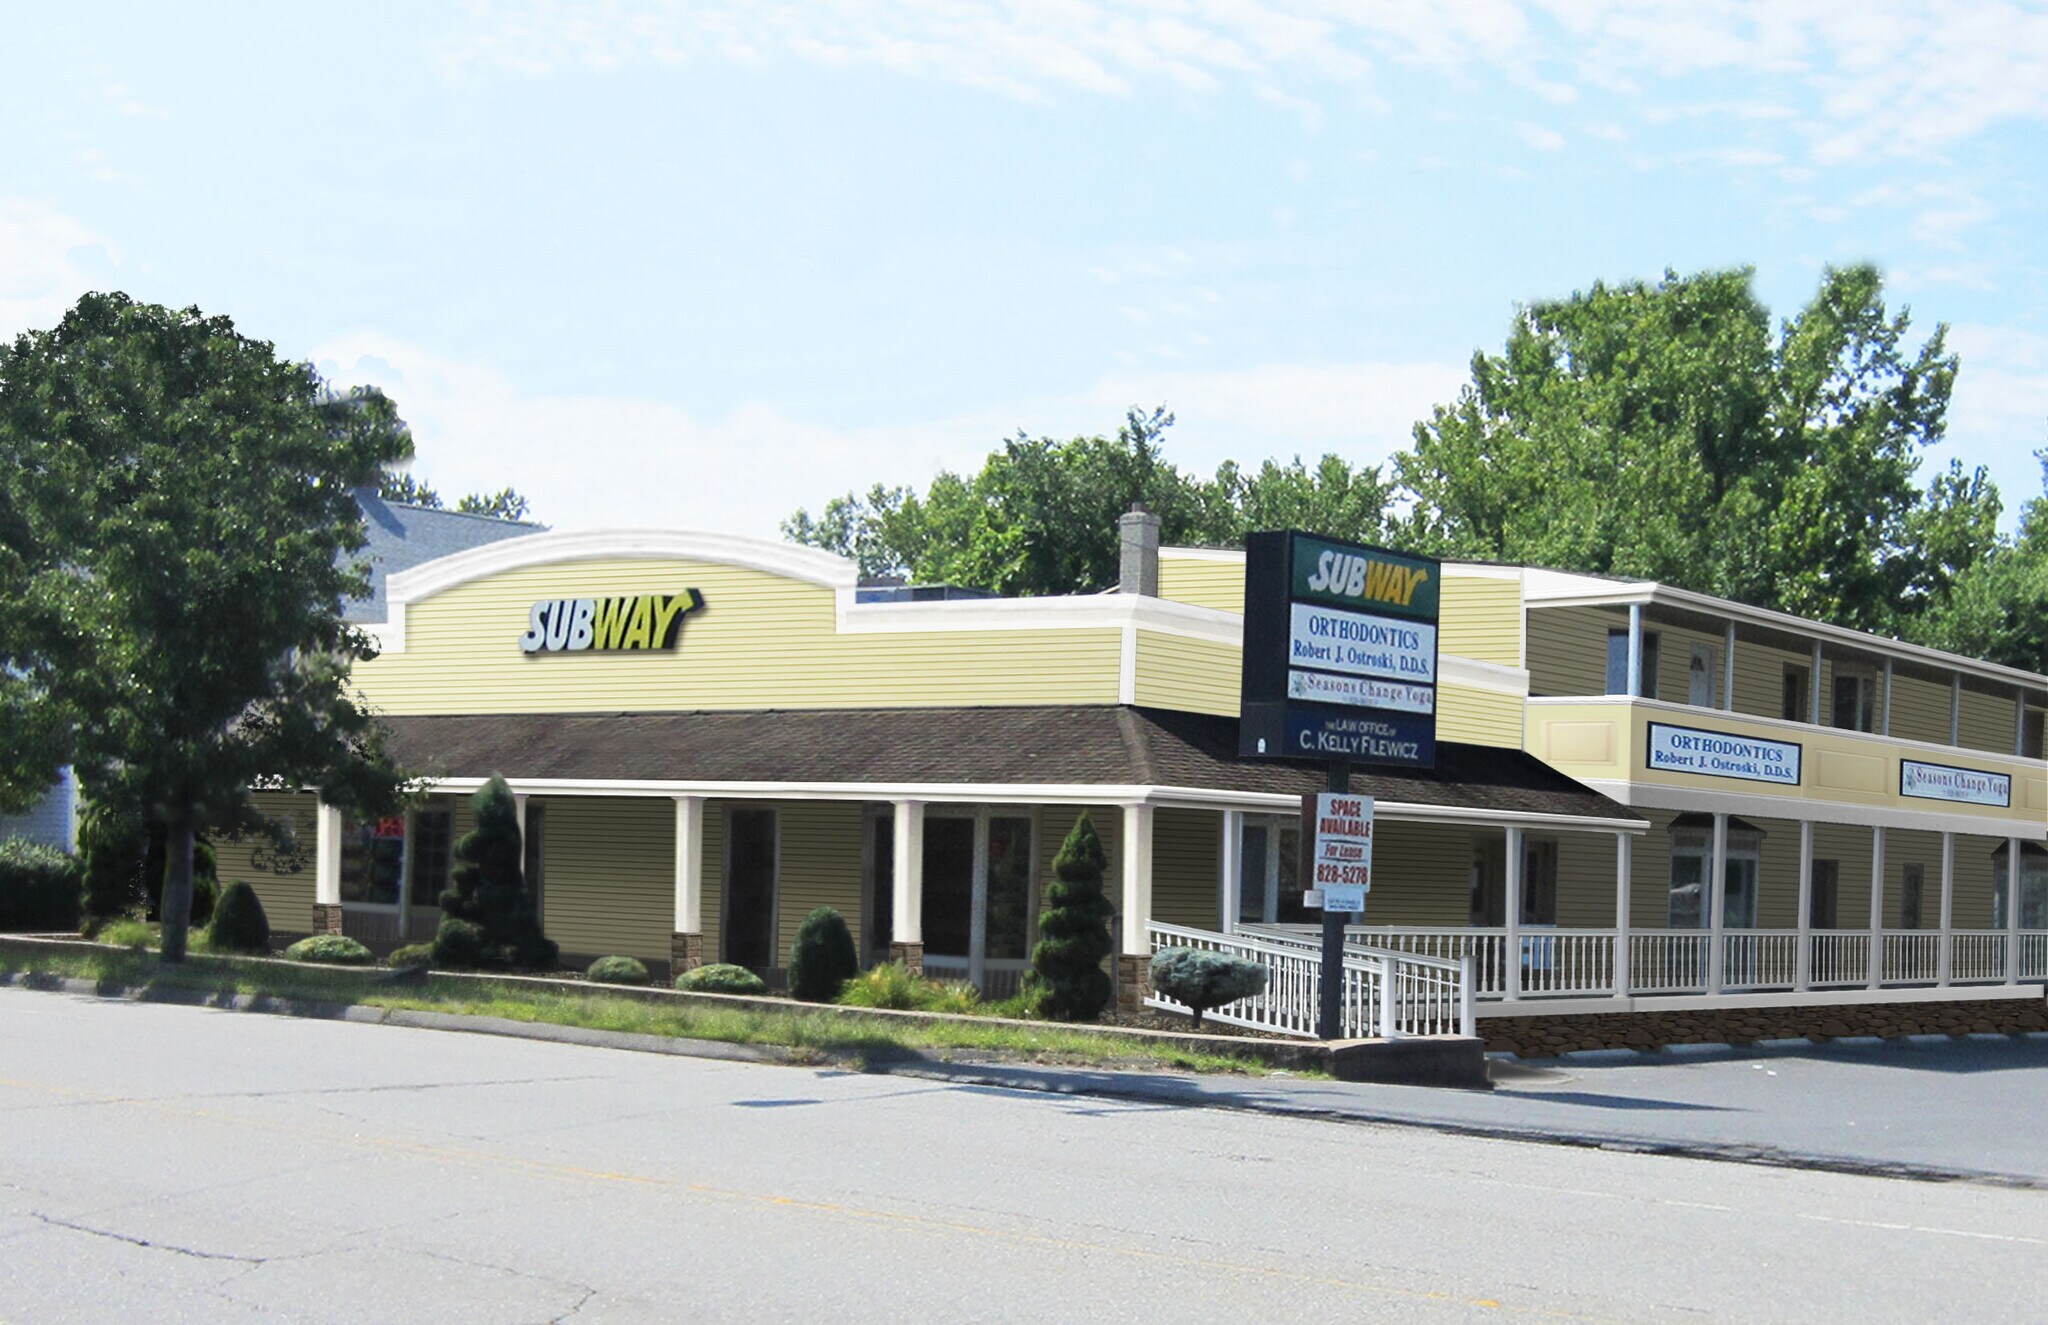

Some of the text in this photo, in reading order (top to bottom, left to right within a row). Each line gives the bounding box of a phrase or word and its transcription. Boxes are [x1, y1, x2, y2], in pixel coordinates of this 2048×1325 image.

[1308, 549, 1429, 607] SUBWAY
[518, 587, 706, 653] SUBWAY
[1309, 614, 1420, 651] ORTHODONTICS
[1293, 639, 1331, 661] Robert
[1335, 645, 1344, 664] J.
[1399, 656, 1429, 675] D.D.S.
[1307, 673, 1432, 705] Seasons Change Yoga
[1299, 729, 1315, 750] C.
[1318, 731, 1360, 754] KELLY
[1336, 719, 1358, 732] LAW
[1358, 721, 1389, 736] OFFICE
[1670, 734, 1784, 763] ORTHODONTICS
[1654, 750, 1694, 766] Robert
[1698, 755, 1708, 768] J.
[1764, 764, 1794, 779] D.D.S.
[1916, 767, 1953, 786] Seasons
[1954, 772, 1986, 795] Change
[1987, 776, 2008, 798] Yoga
[1330, 798, 1361, 818] SPACE
[1320, 817, 1370, 838] AVAILABLE
